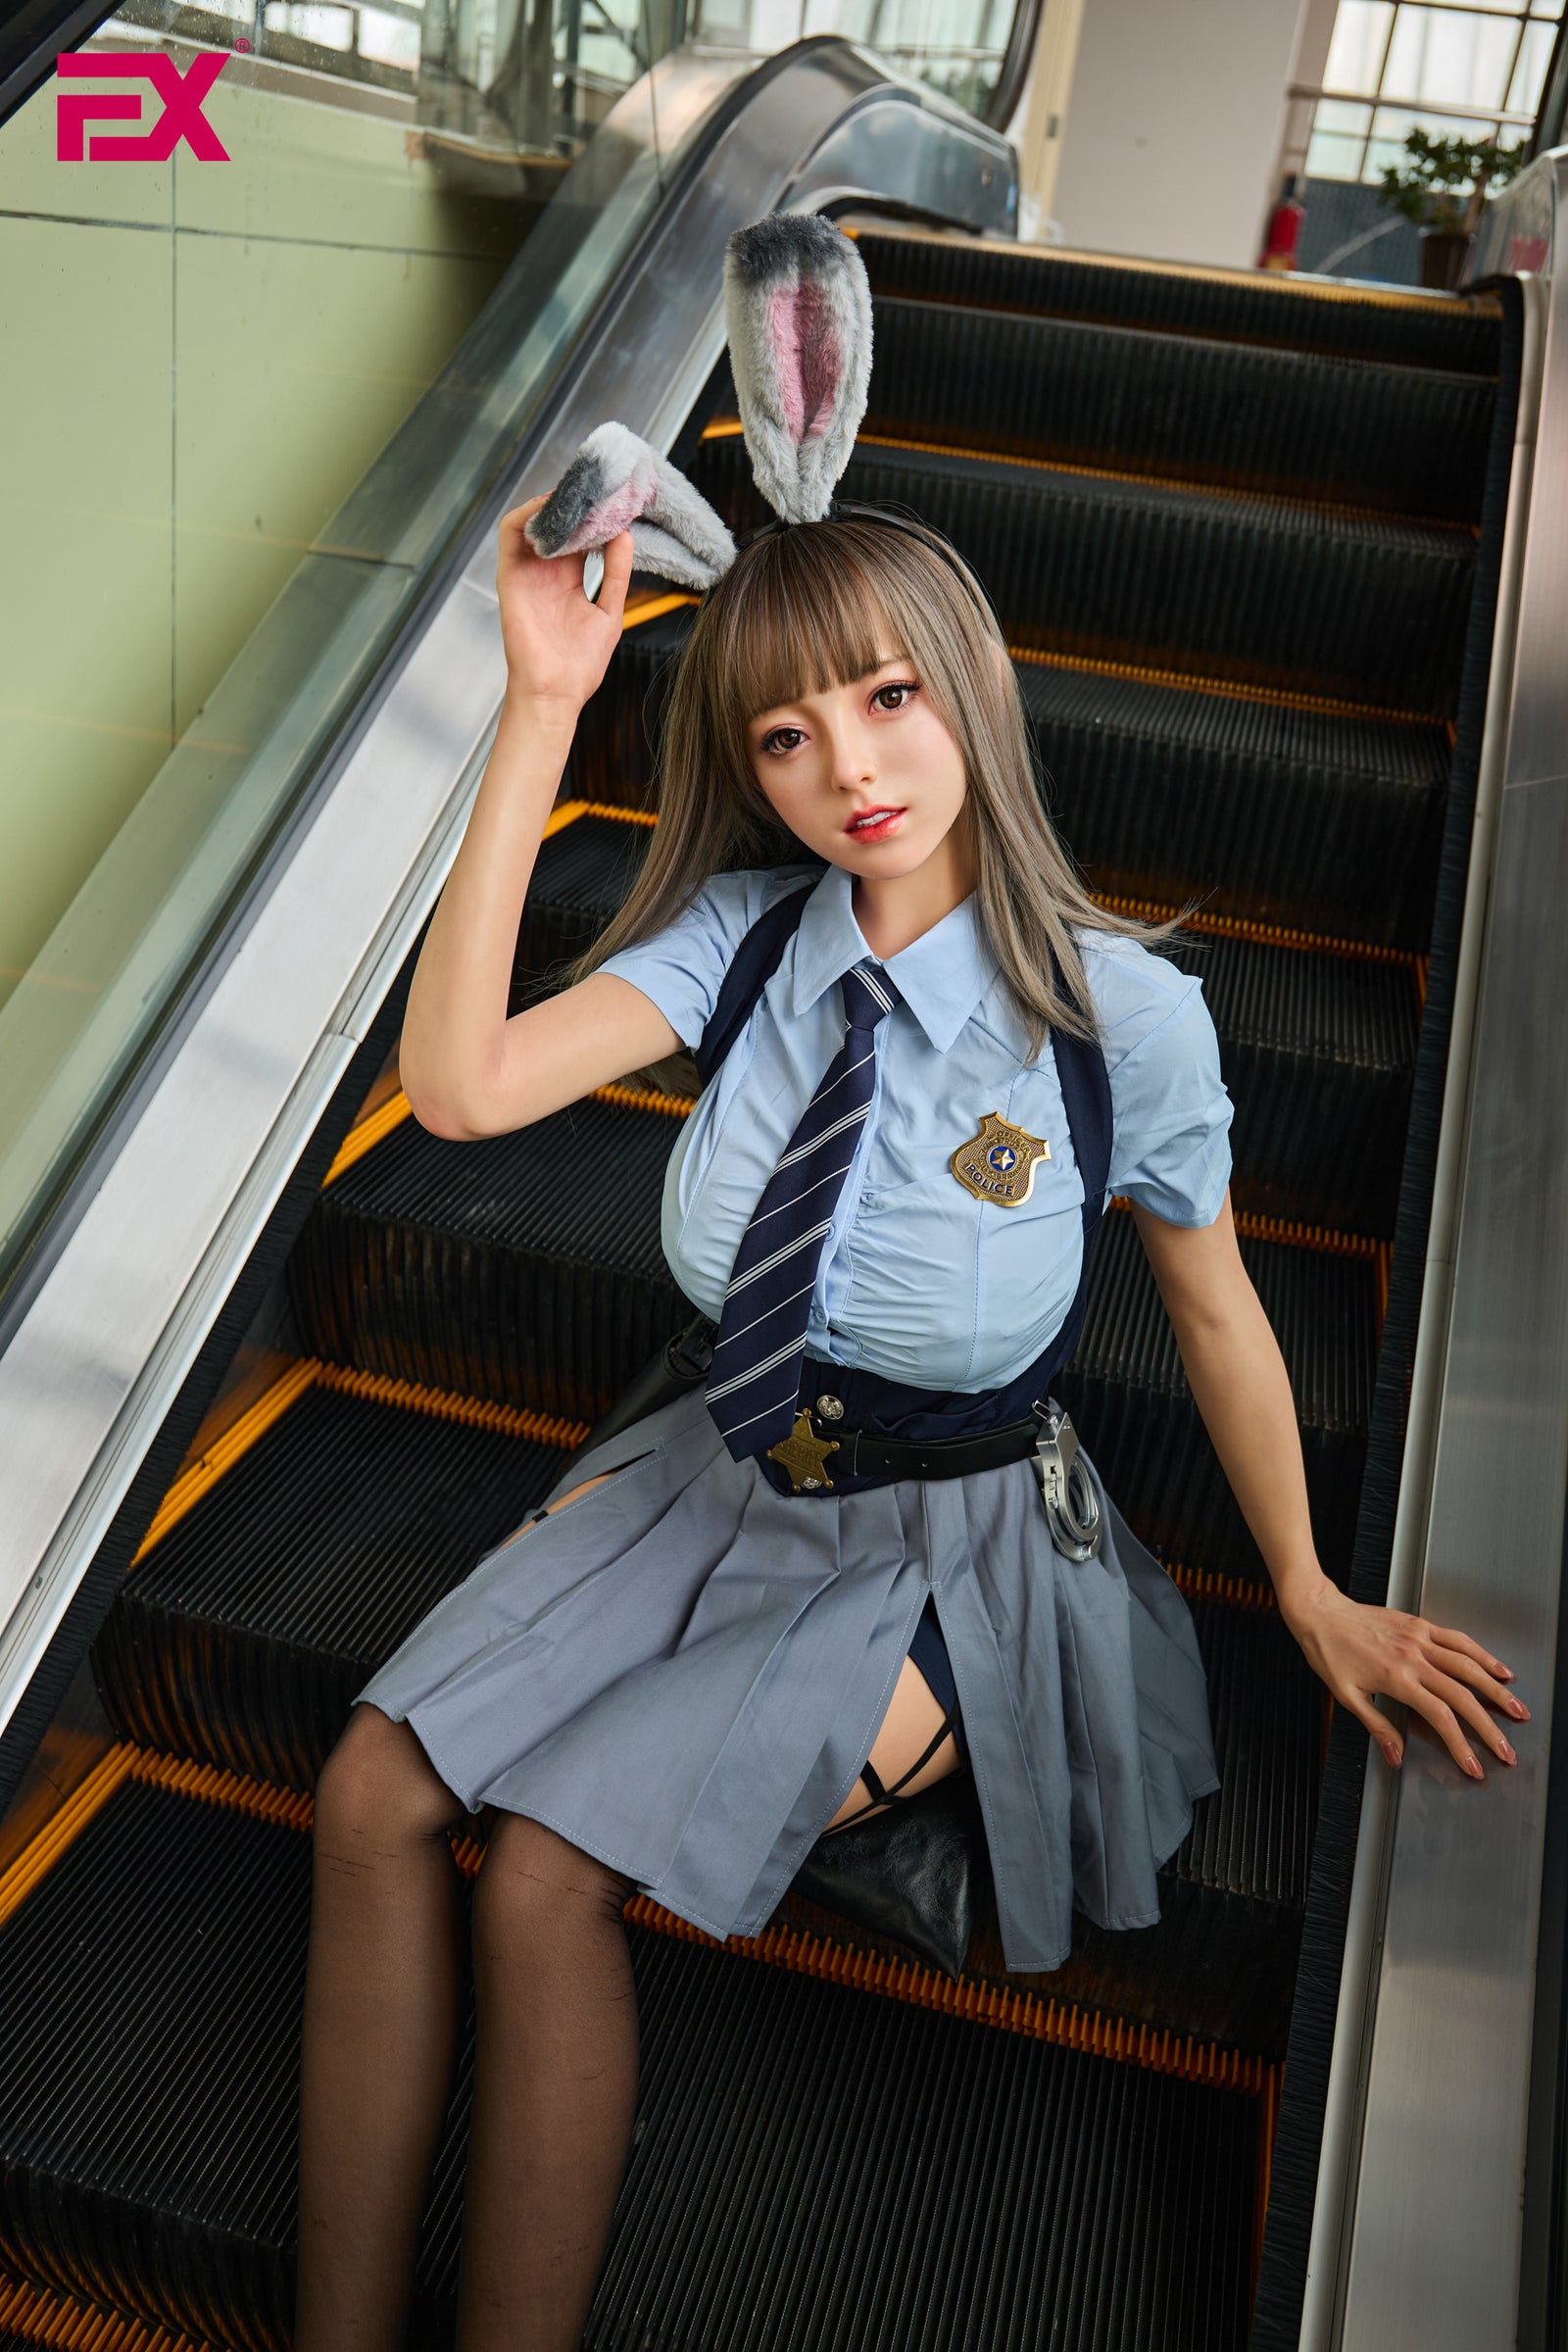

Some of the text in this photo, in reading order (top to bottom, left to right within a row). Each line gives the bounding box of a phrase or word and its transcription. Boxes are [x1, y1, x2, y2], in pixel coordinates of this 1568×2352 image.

[996, 1130, 1031, 1153] OFFICER
[965, 1163, 1014, 1195] POLICE
[777, 1440, 821, 1467] SHERIFF
